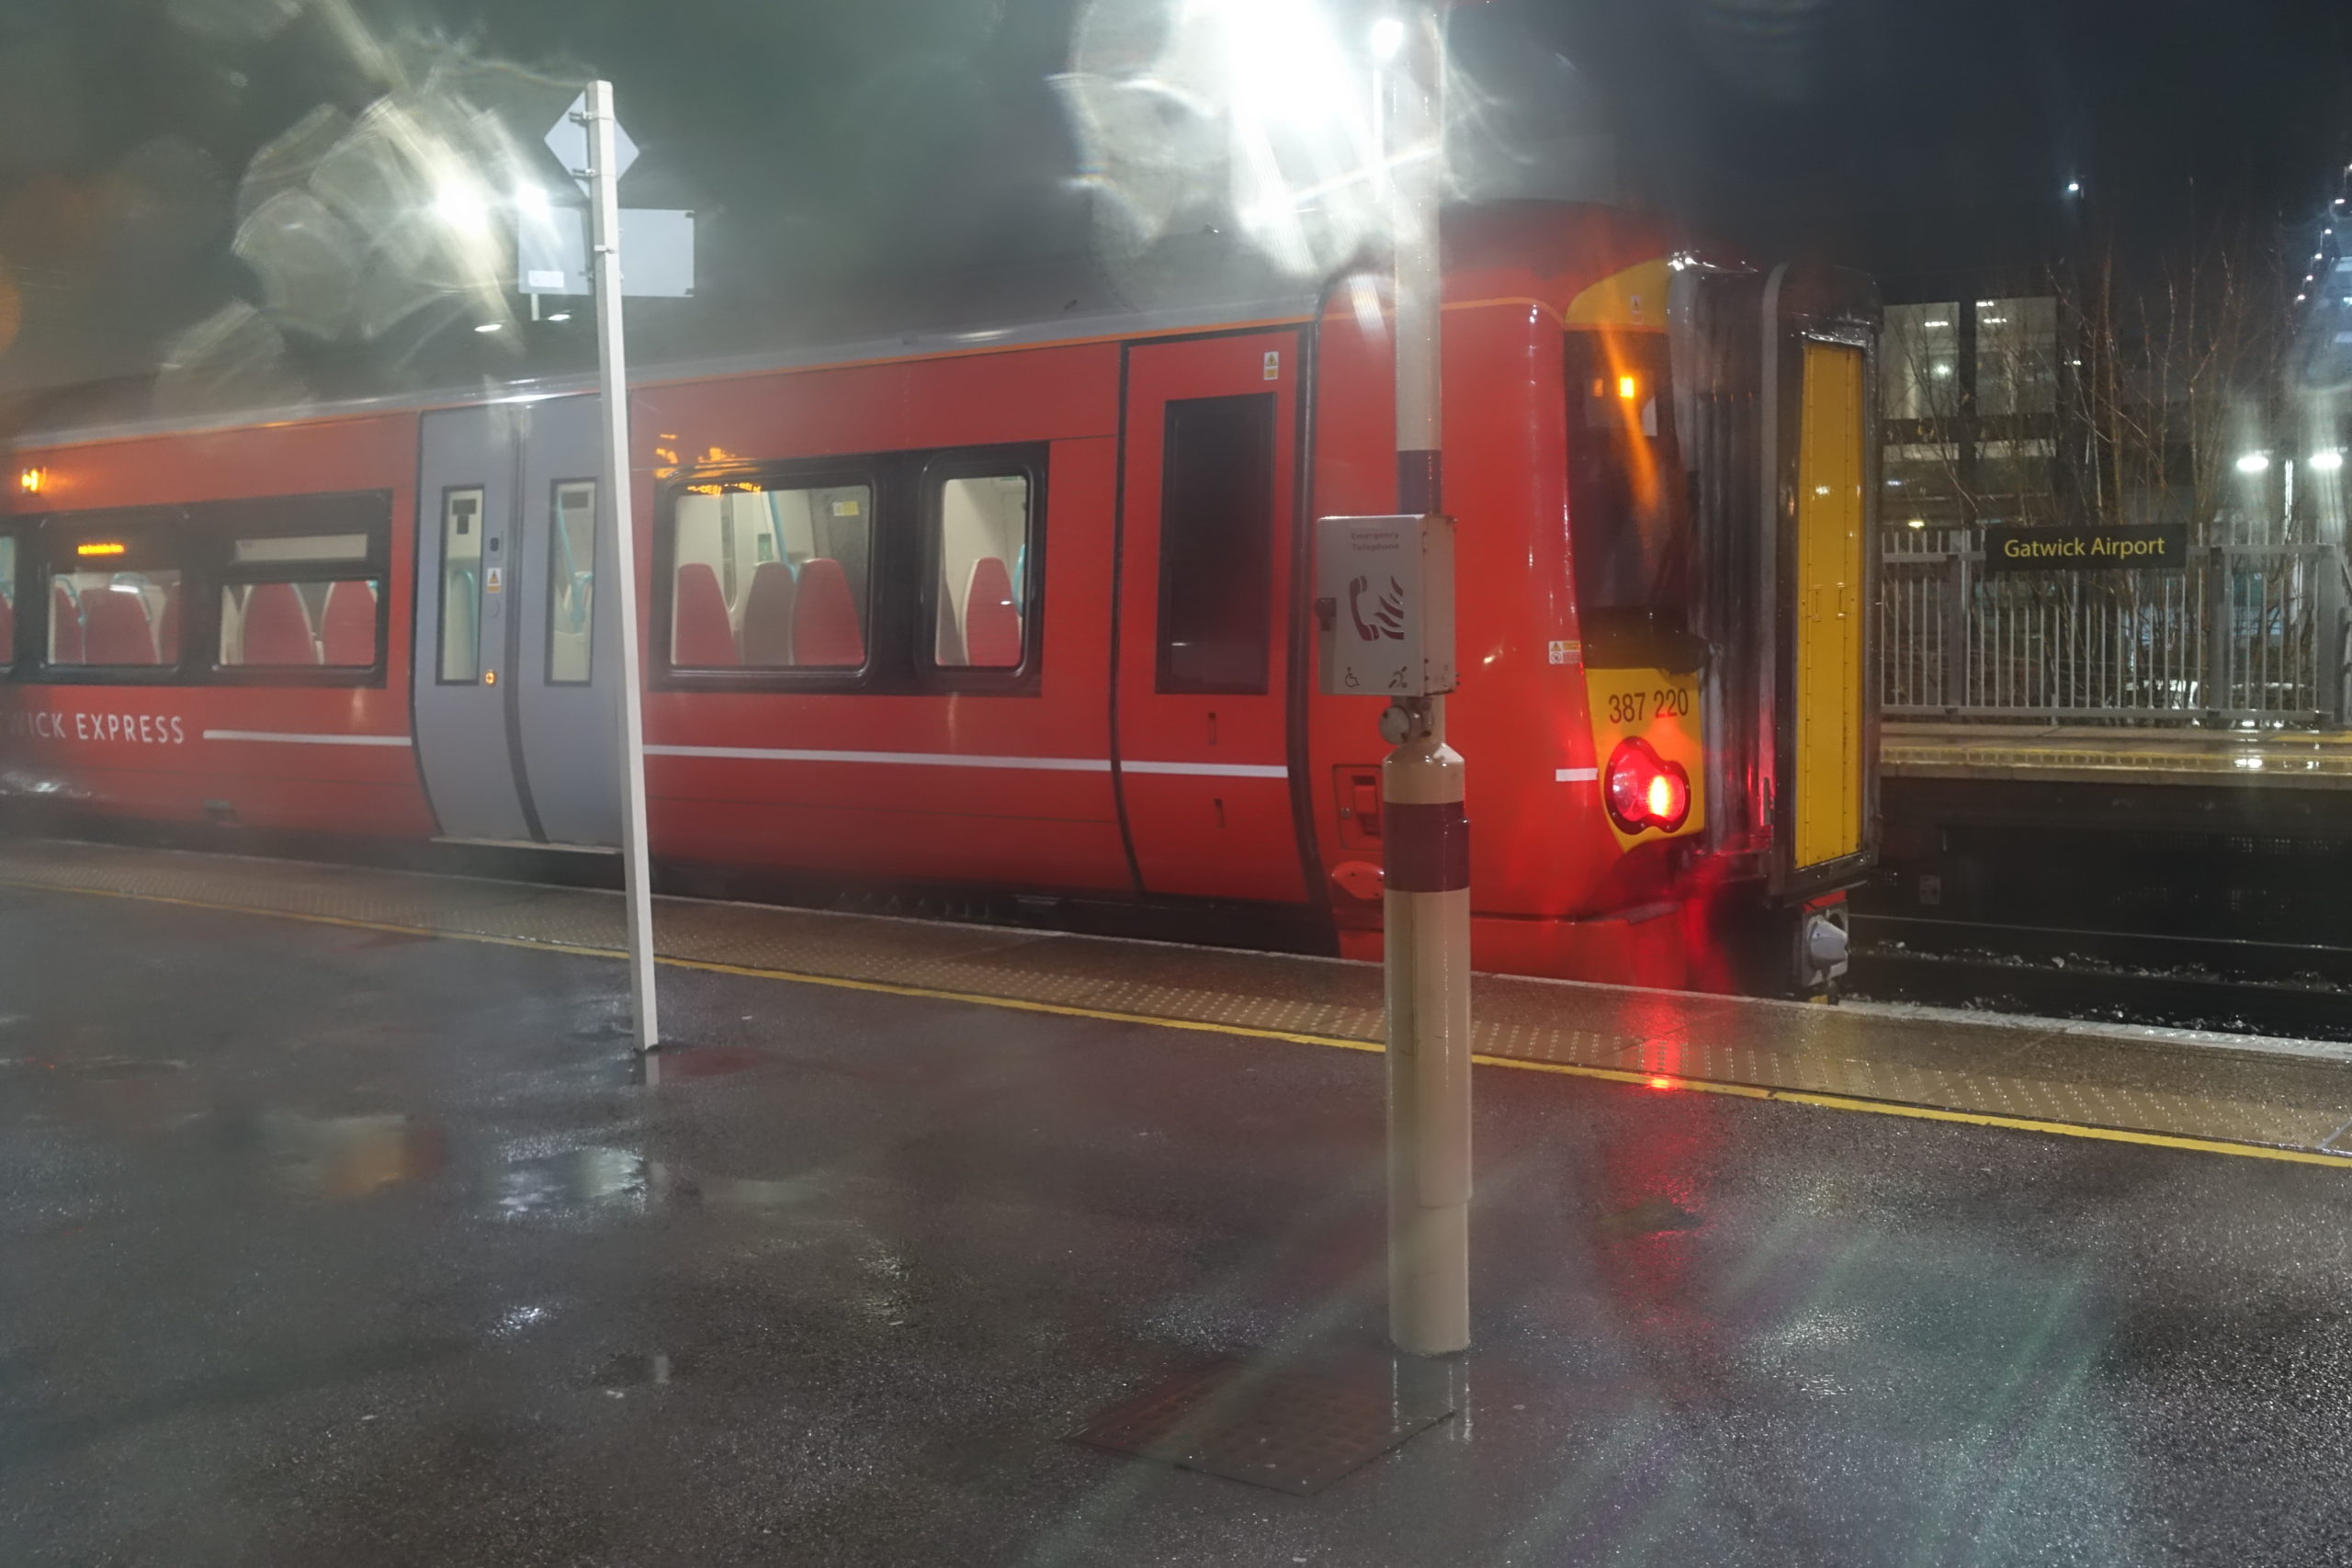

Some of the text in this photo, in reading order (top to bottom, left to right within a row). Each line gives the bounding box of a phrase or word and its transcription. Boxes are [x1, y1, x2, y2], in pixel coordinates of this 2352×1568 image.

[2004, 537, 2165, 559] Gatwick Airport
[1609, 688, 1689, 724] 387 220
[75, 713, 184, 744] EXPRESS
